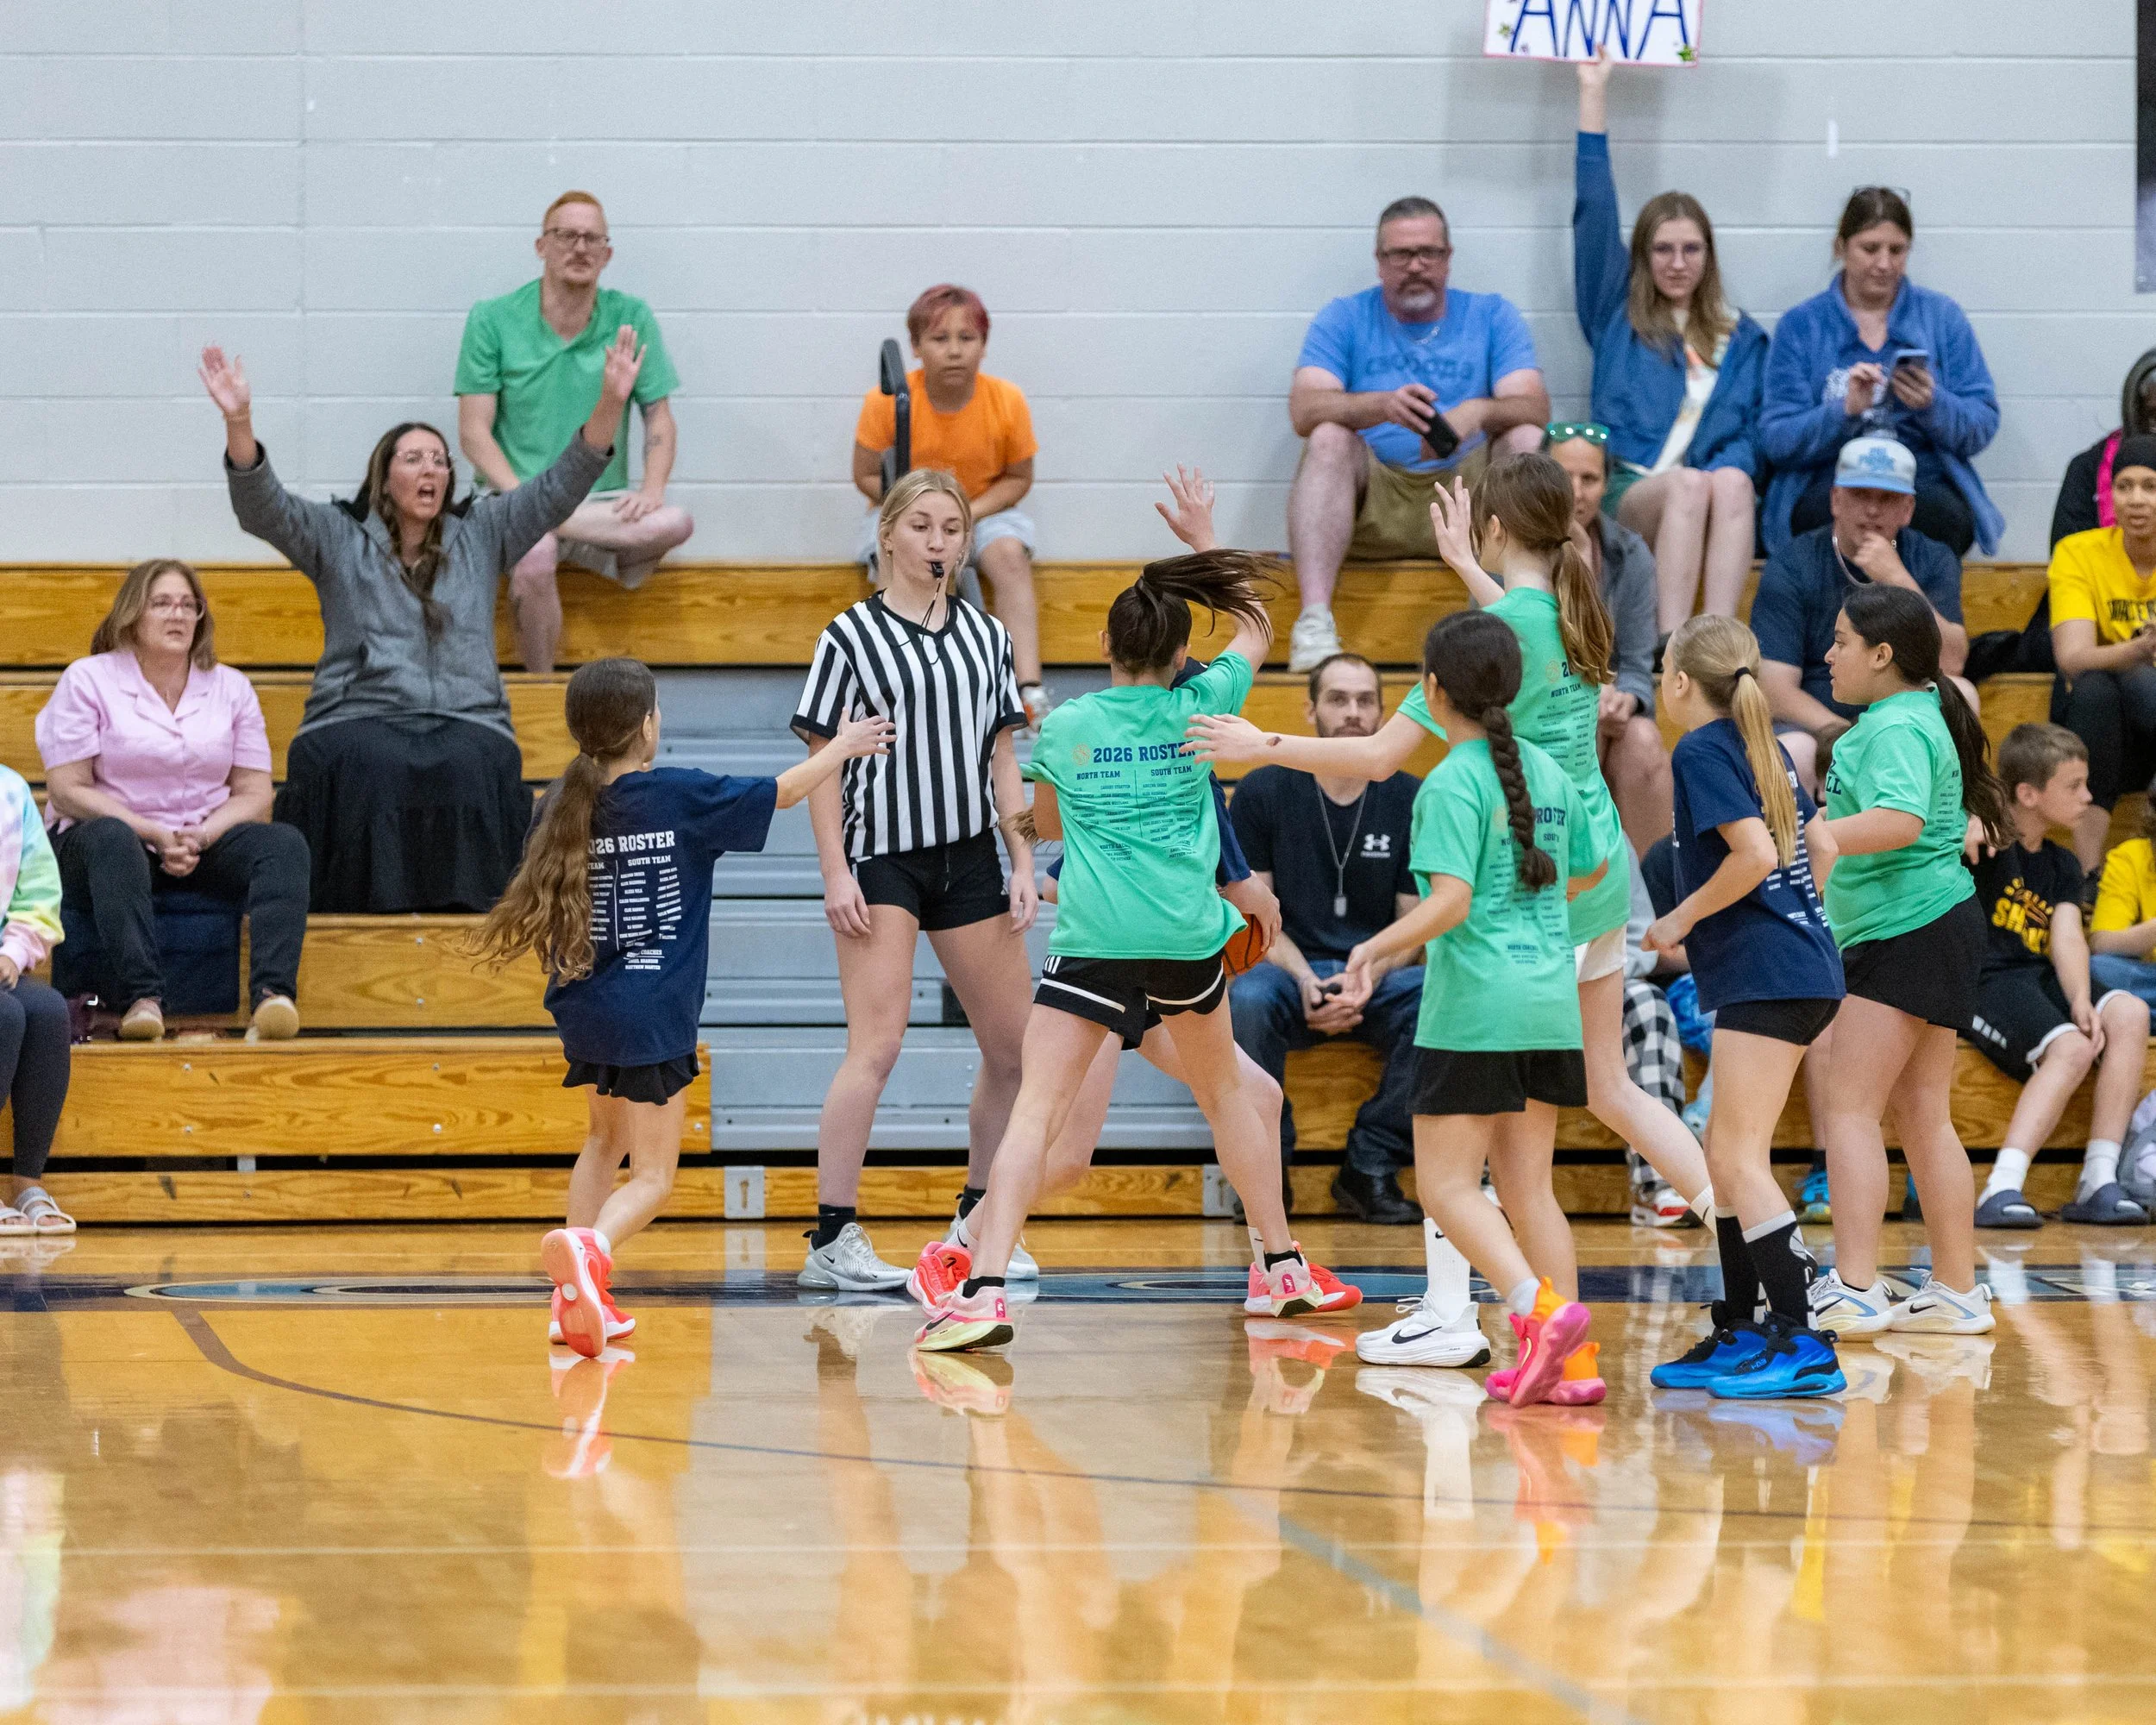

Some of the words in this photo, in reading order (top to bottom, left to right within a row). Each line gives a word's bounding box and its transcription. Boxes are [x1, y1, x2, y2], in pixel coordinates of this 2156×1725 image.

[1510, 0, 1690, 60] ANNA
[1094, 747, 1133, 763] 2026
[1150, 768, 1171, 776] SOUTH
[1174, 765, 1193, 775] TEAM
[588, 837, 615, 854] 026
[617, 831, 675, 852] ROSTER
[627, 856, 651, 867] SOUTH
[651, 855, 672, 864] TEAM
